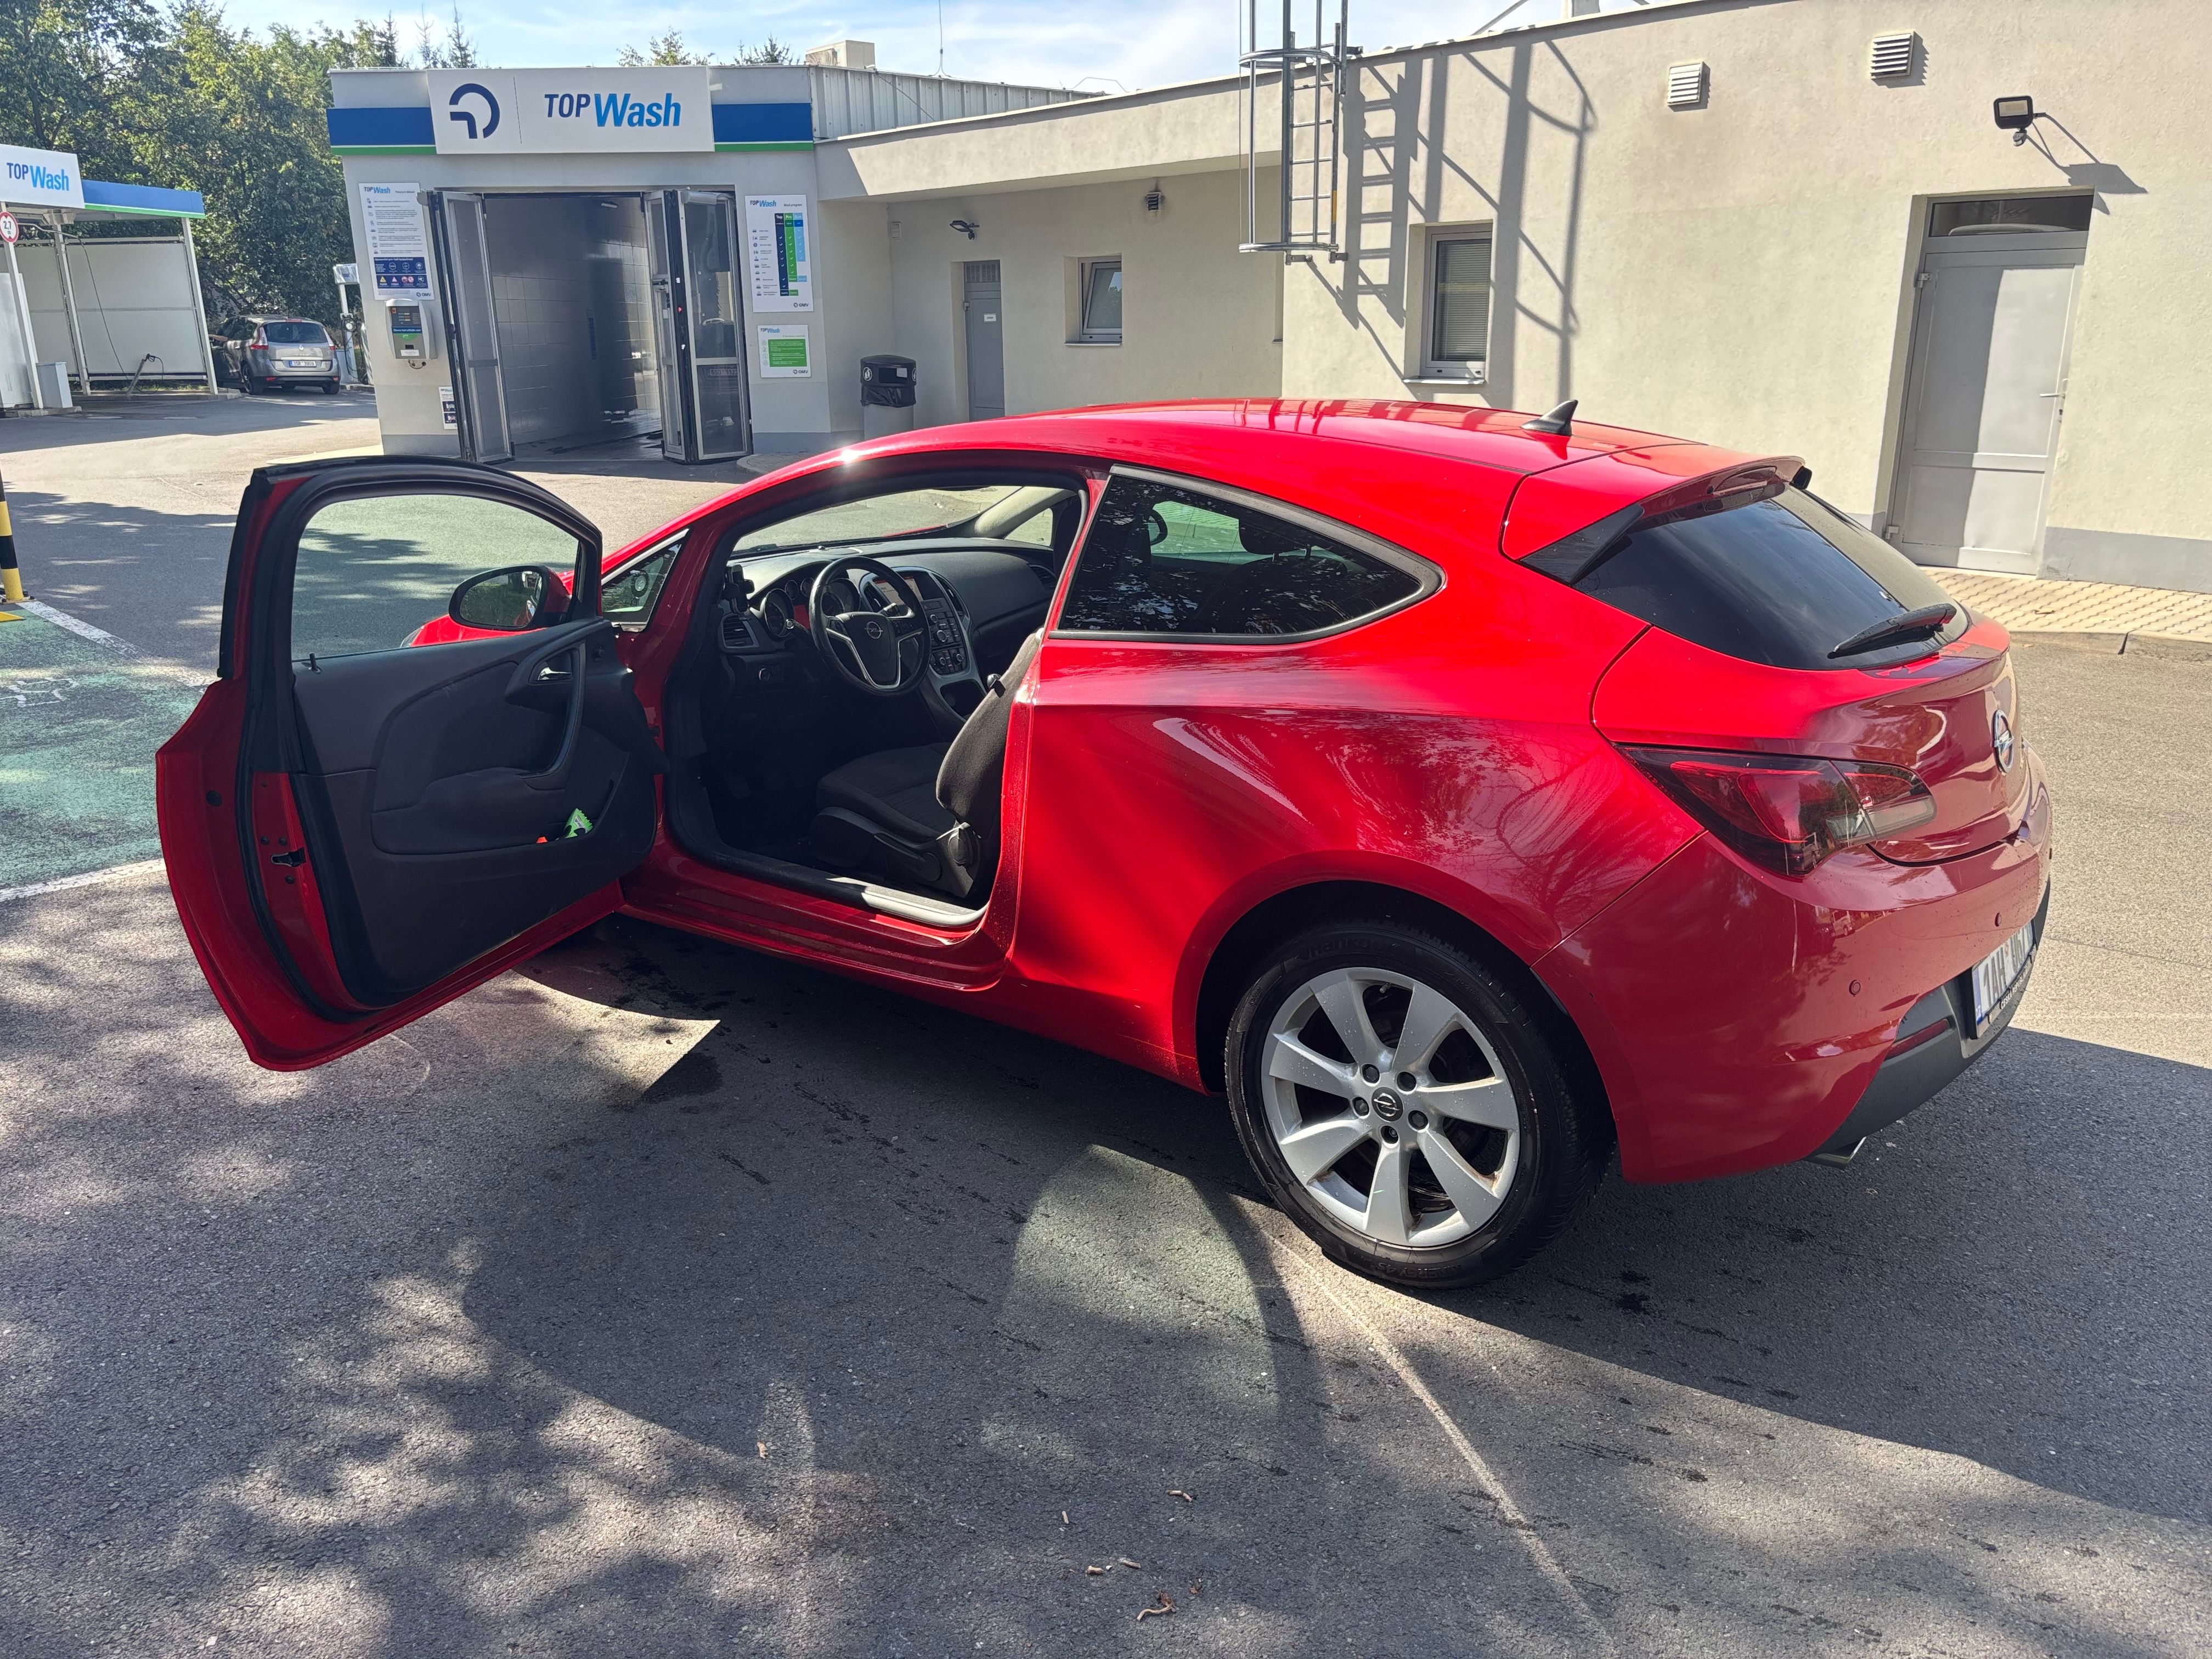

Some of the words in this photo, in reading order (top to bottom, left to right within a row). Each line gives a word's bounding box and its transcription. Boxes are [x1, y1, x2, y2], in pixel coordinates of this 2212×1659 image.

[544, 93, 591, 118] TOP
[594, 93, 681, 127] Wash
[7, 162, 29, 180] TOP
[30, 165, 69, 191] Wash
